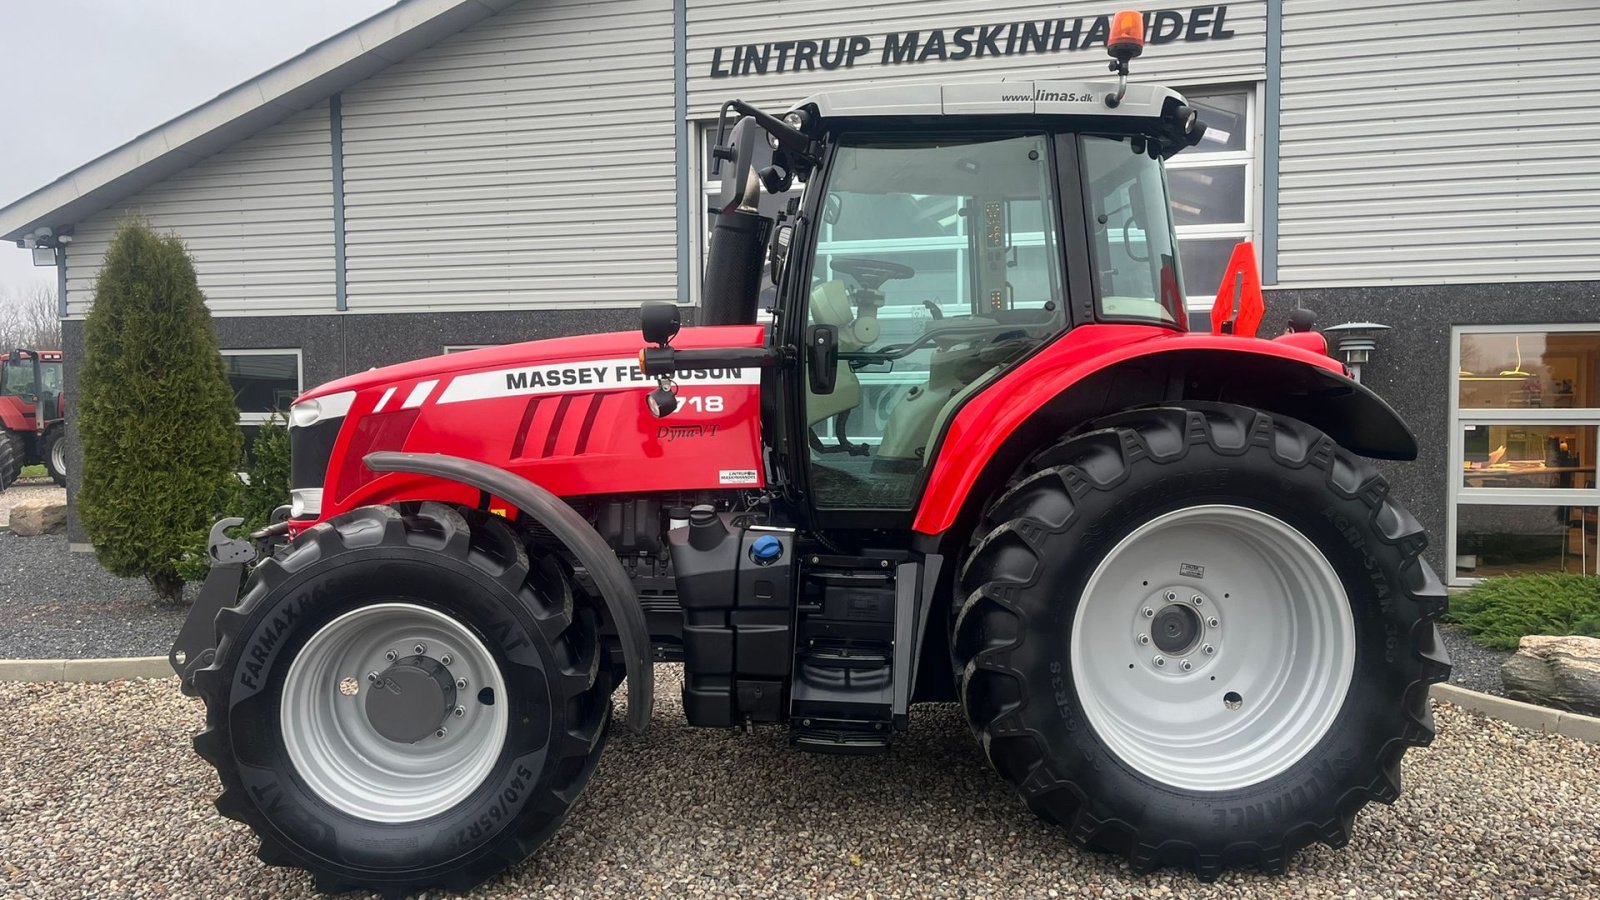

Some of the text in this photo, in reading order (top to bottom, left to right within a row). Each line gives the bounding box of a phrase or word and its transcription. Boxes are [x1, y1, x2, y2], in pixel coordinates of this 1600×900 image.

[710, 6, 1235, 78] LINTRUP MASKINHADEL
[1002, 89, 1094, 102] www.limas.dk
[506, 366, 742, 390] MASSEY FEUSON
[673, 395, 724, 413] 718
[240, 602, 301, 690] FARMAX
